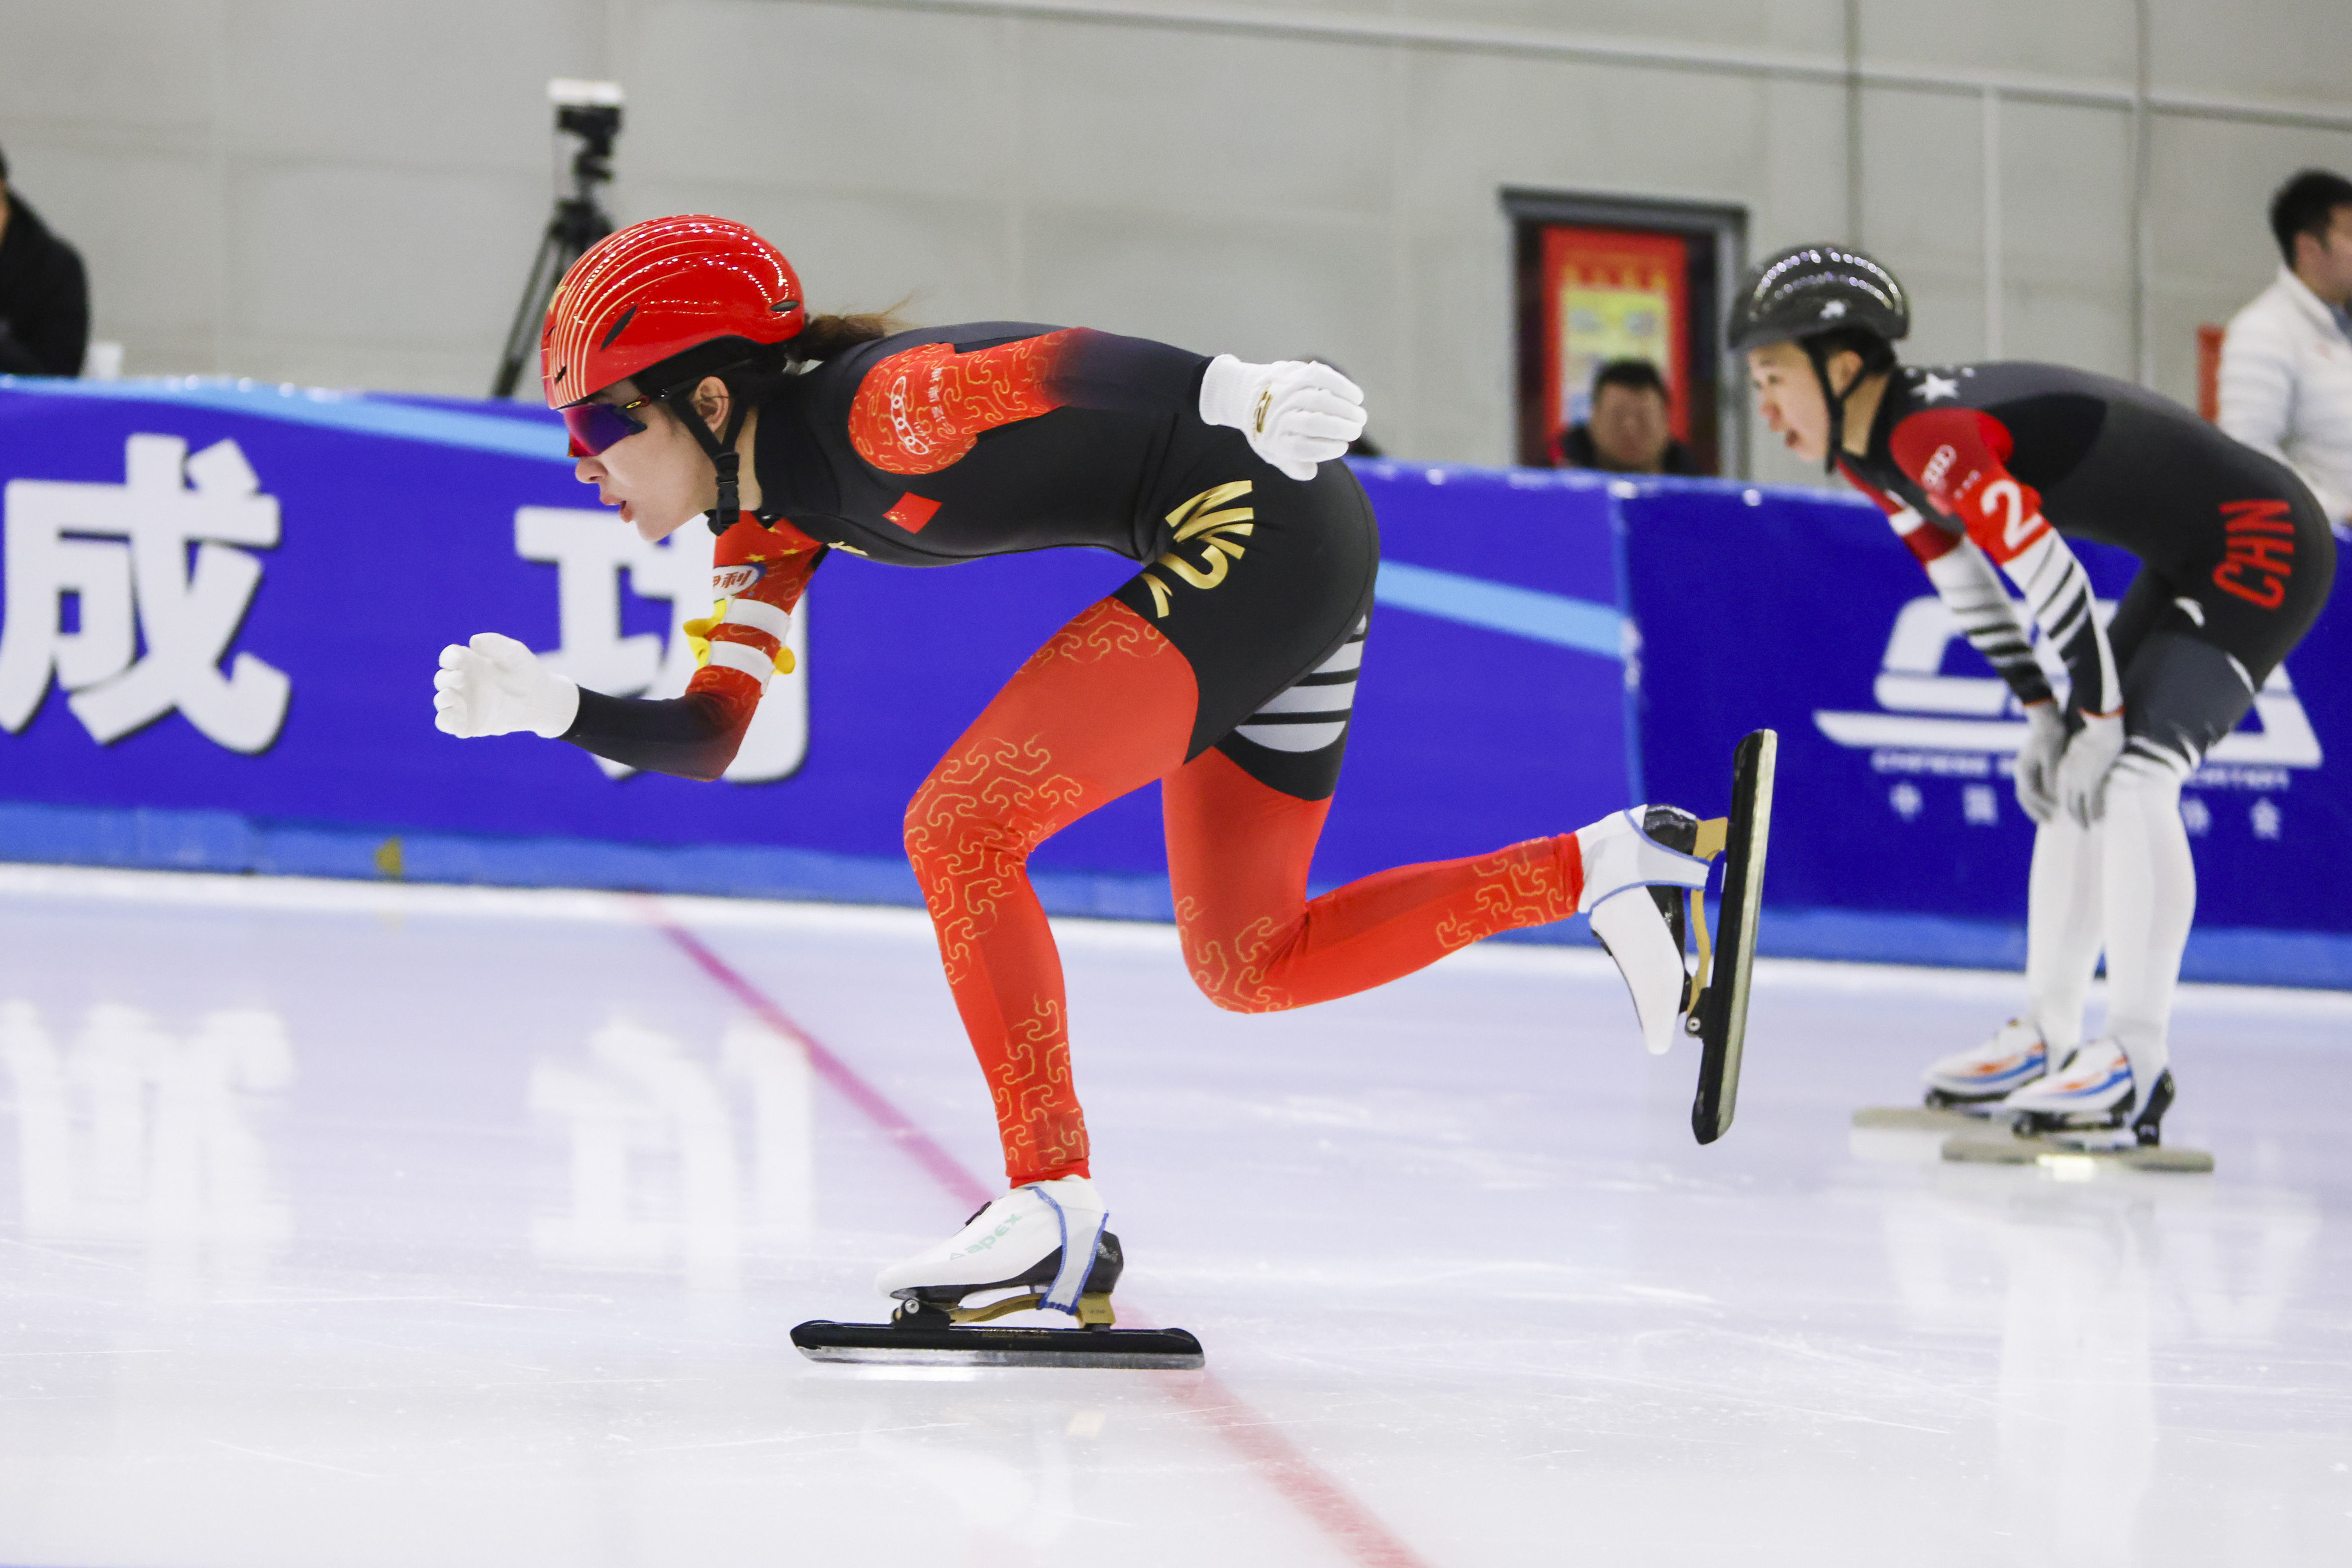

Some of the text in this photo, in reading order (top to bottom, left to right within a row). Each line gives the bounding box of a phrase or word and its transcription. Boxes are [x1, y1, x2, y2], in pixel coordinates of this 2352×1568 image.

[1980, 479, 2044, 549] 2
[2213, 499, 2295, 610] CHN
[964, 1213, 1023, 1254] apex
